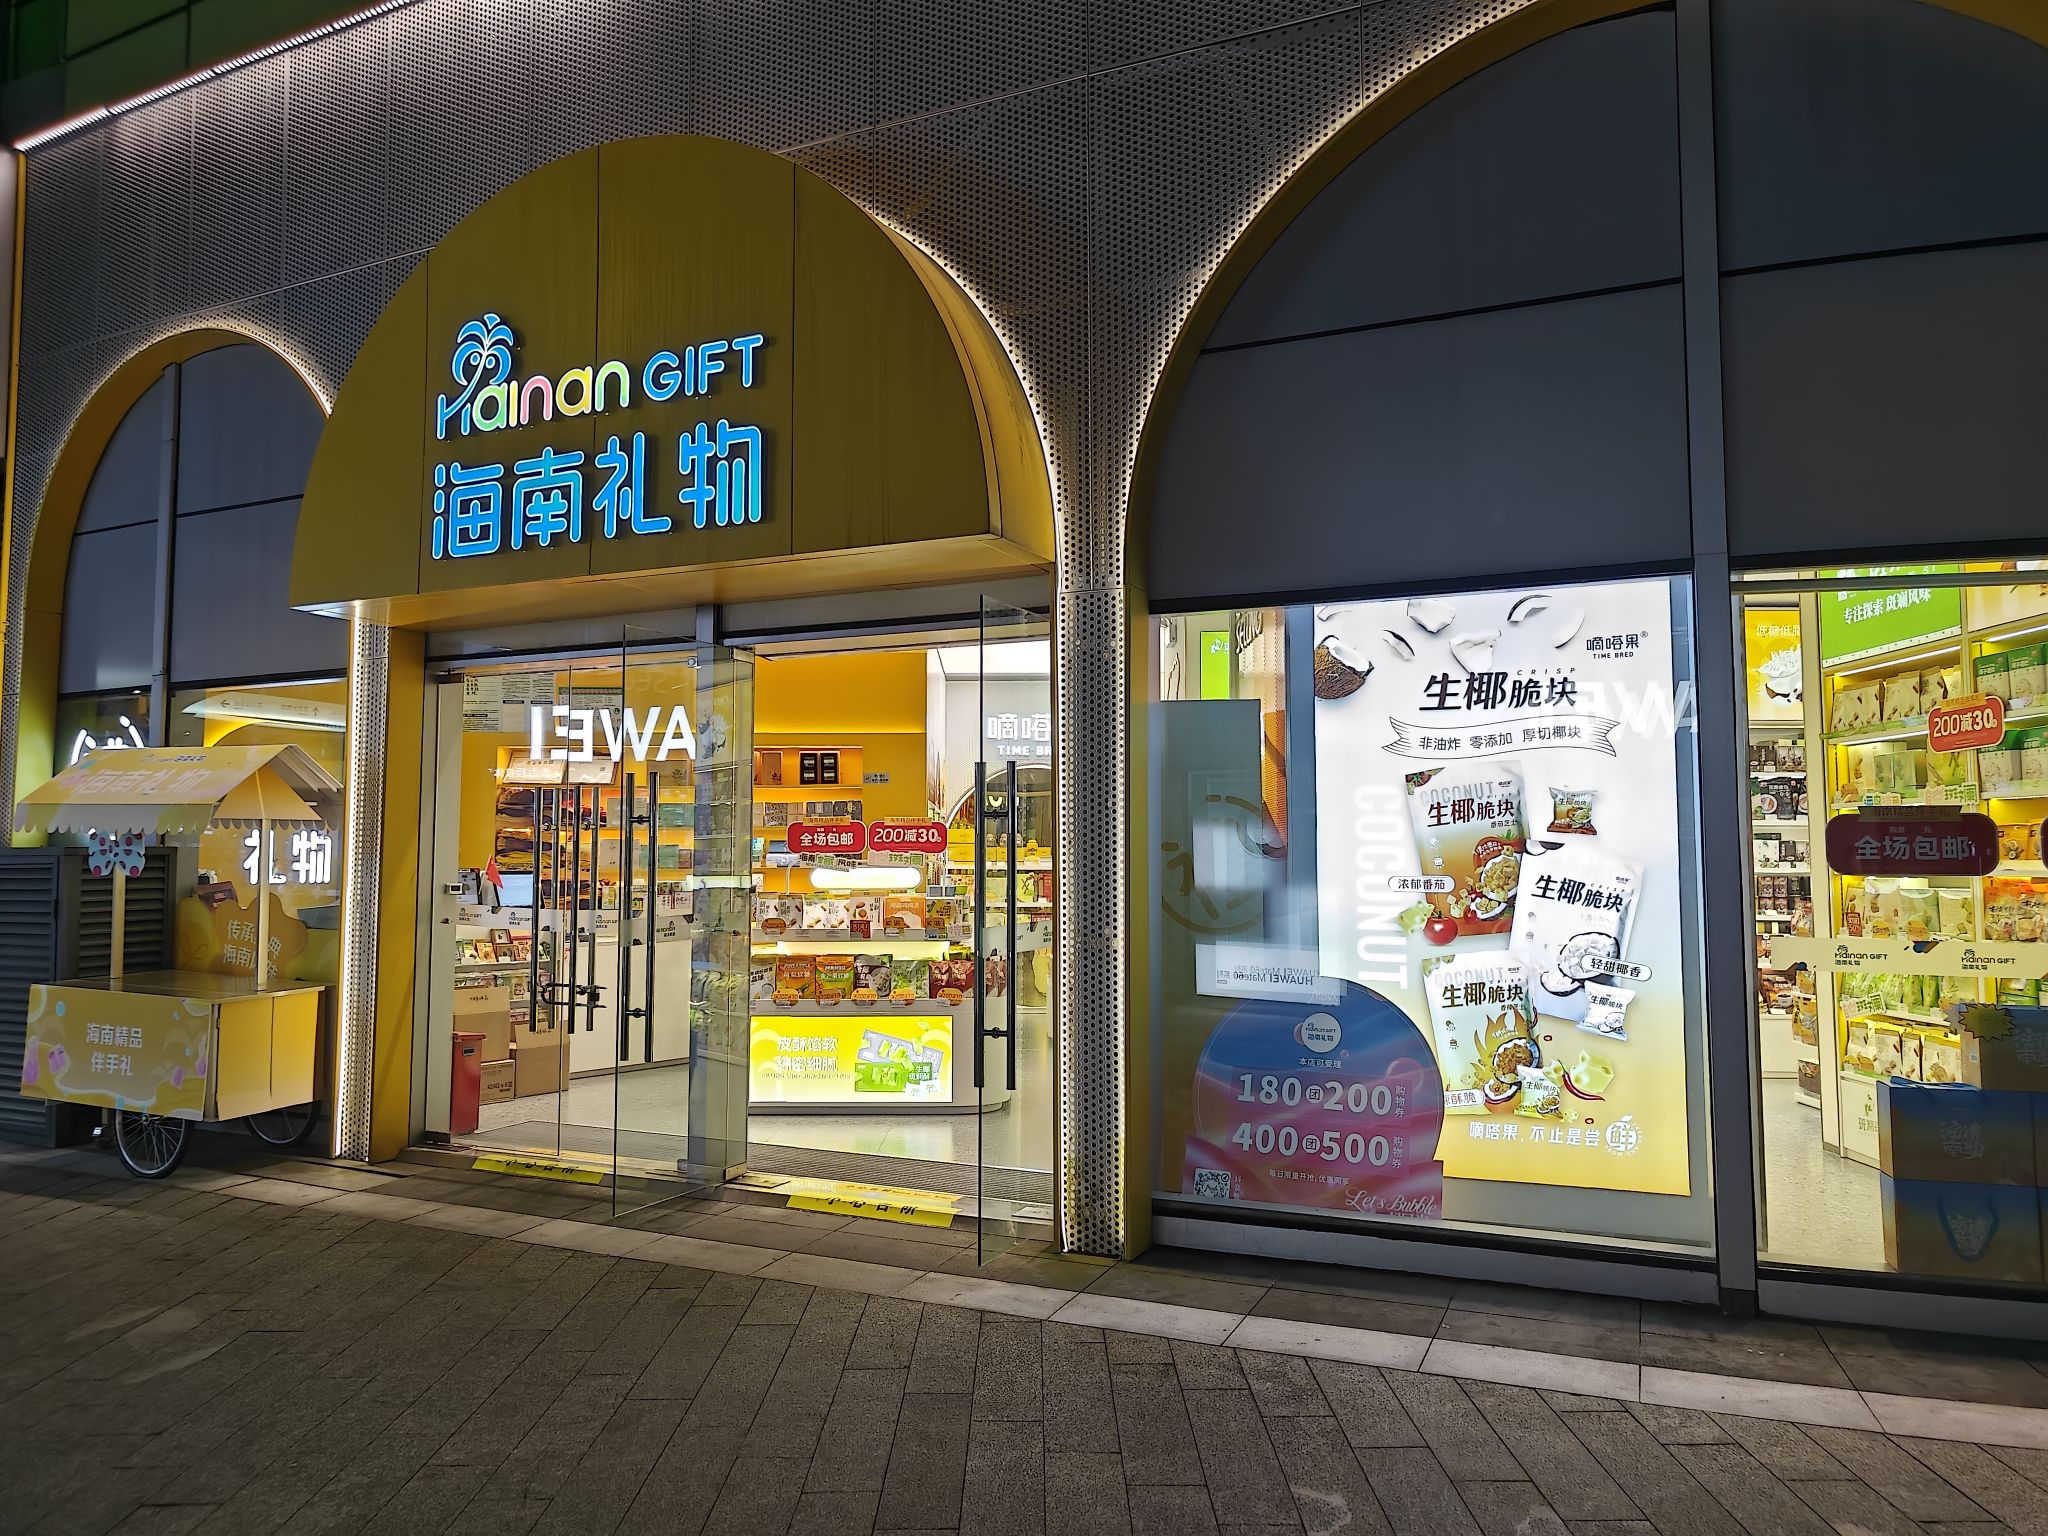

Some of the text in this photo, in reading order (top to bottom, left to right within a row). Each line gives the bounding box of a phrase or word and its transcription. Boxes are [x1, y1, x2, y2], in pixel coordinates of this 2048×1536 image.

[435, 323, 764, 440] Hainan GIFT
[431, 418, 763, 560] 海南礼物
[1614, 651, 1634, 659] BRED
[1516, 667, 1577, 676] CRISP
[1418, 671, 1578, 711] 生椰脆块
[998, 745, 1030, 756] TIME
[1418, 725, 1581, 751] 非油炸 零添加 厚切椰块
[1420, 781, 1494, 806] COCONUT
[1427, 797, 1515, 828] 生椰脆块
[799, 832, 854, 847] 全场包邮
[1853, 834, 1969, 861] 全场包邮
[243, 828, 333, 885] 礼物
[1354, 786, 1409, 990] COCONUT
[1398, 877, 1446, 891] 浓郁番茄
[1531, 874, 1624, 913] 生椰脆块
[1590, 957, 1642, 978] 轻甜椰香
[1869, 953, 1888, 961] GIFT
[1996, 958, 2016, 966] GIFT
[1442, 982, 1524, 1009] 生椰脆块
[86, 1022, 142, 1049] 海南精品
[91, 1051, 134, 1077] 伴手礼
[1299, 1057, 1342, 1069] 本店可受理
[1386, 1195, 1437, 1215] Bubble
